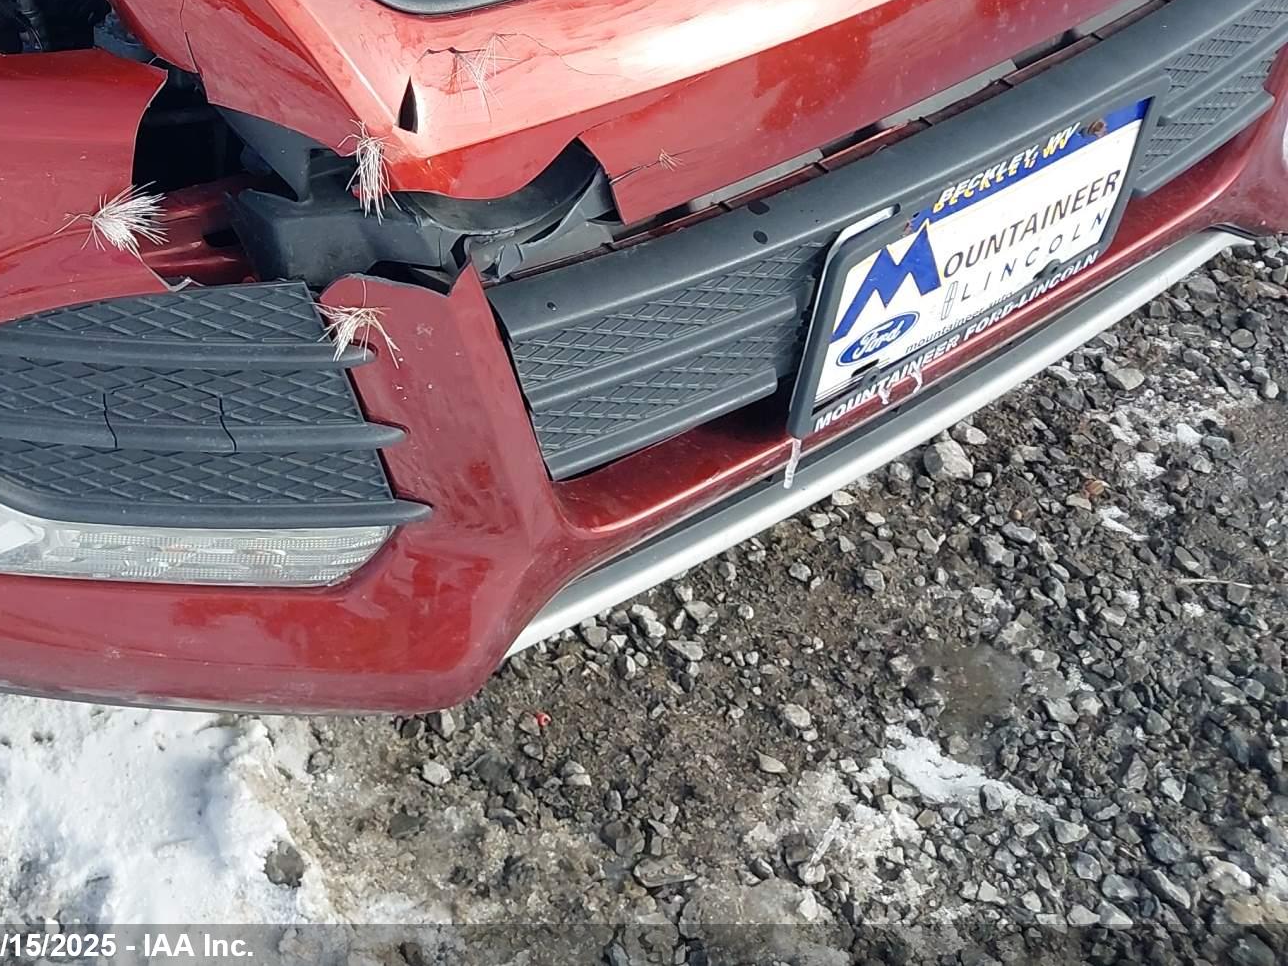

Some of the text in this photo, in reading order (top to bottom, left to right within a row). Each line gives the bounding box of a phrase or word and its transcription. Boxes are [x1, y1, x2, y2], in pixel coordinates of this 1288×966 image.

[960, 207, 1108, 302] LINCOLN
[814, 250, 1099, 433] MOUNTAINEER FORD-LINCOLN
[851, 318, 904, 360] Ford
